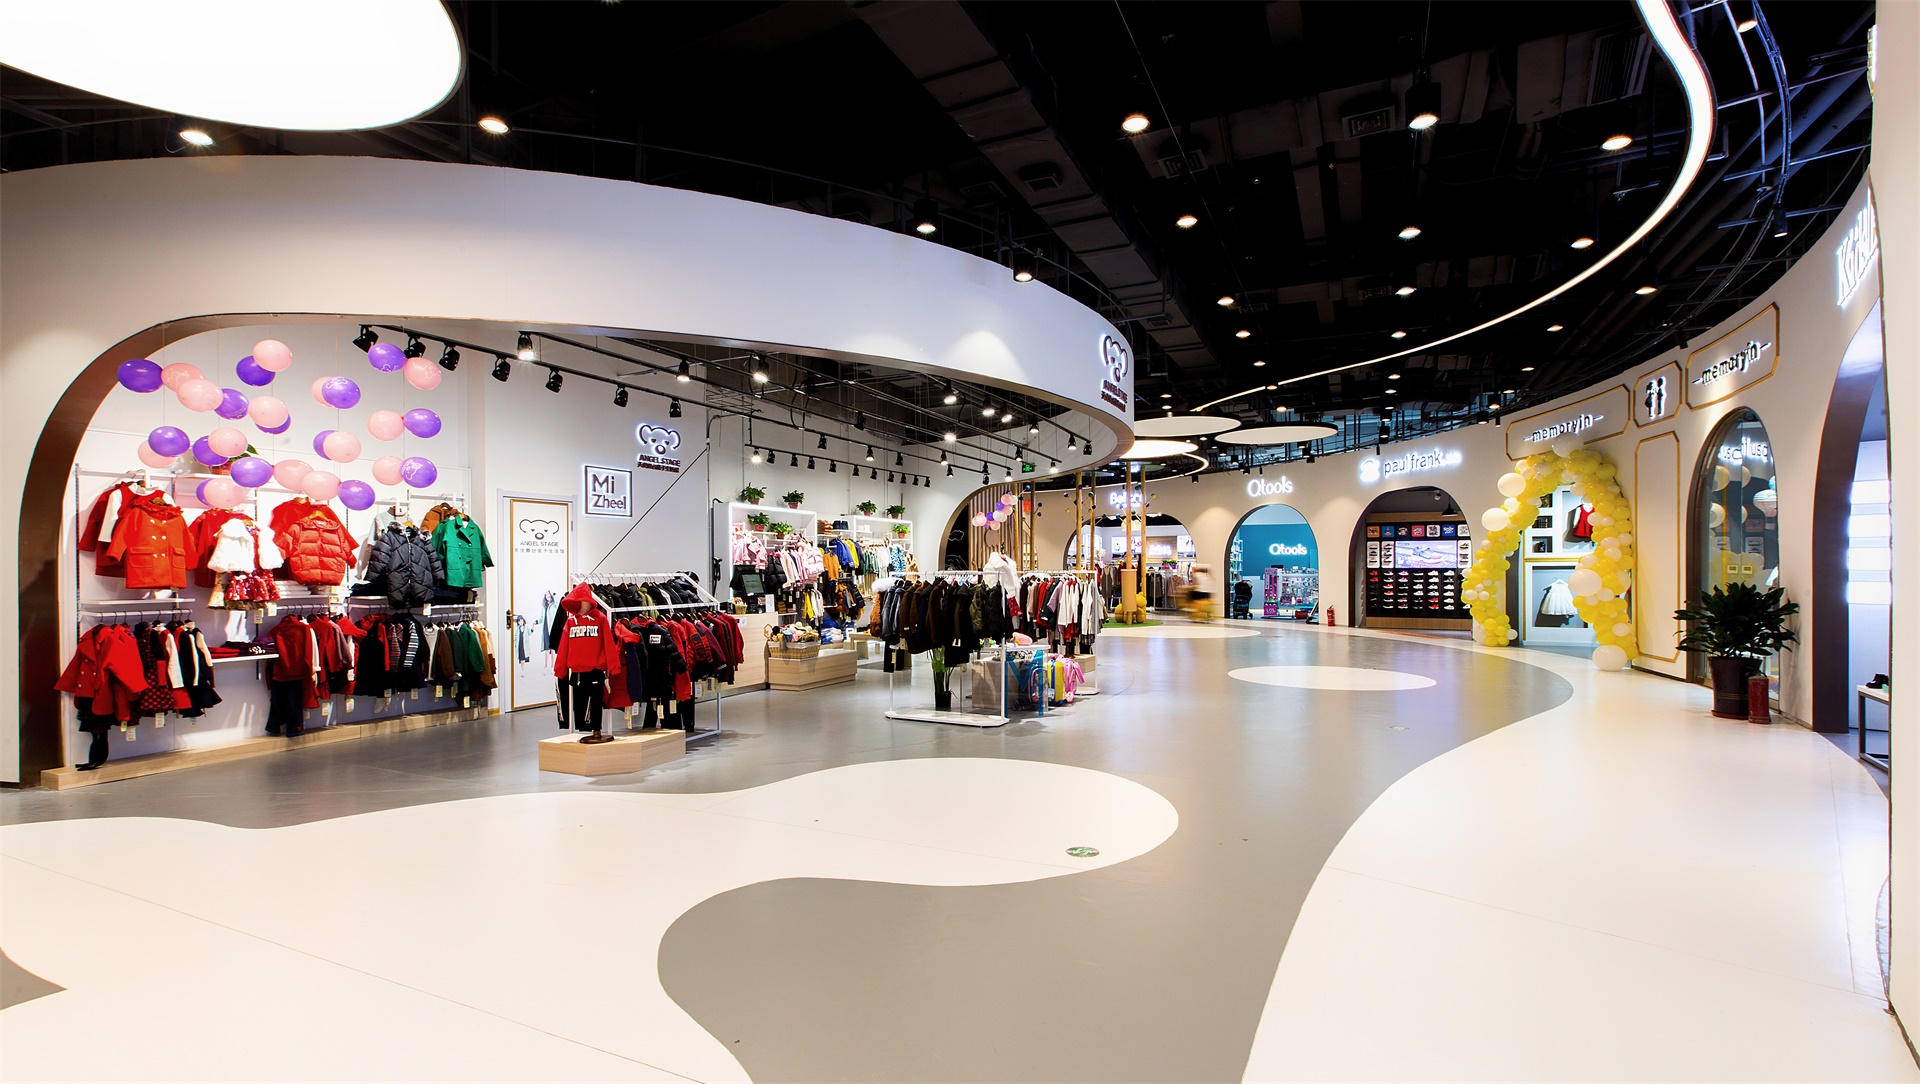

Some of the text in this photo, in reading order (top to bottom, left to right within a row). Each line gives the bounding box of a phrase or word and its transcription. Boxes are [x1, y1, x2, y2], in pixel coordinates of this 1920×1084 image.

[1384, 456, 1408, 477] paul
[1411, 449, 1441, 471] frank
[592, 473, 615, 494] Mi
[1247, 475, 1293, 497] Qtools
[592, 494, 627, 509] Zheel
[1269, 543, 1308, 555] Qtools
[586, 626, 599, 637] FOX
